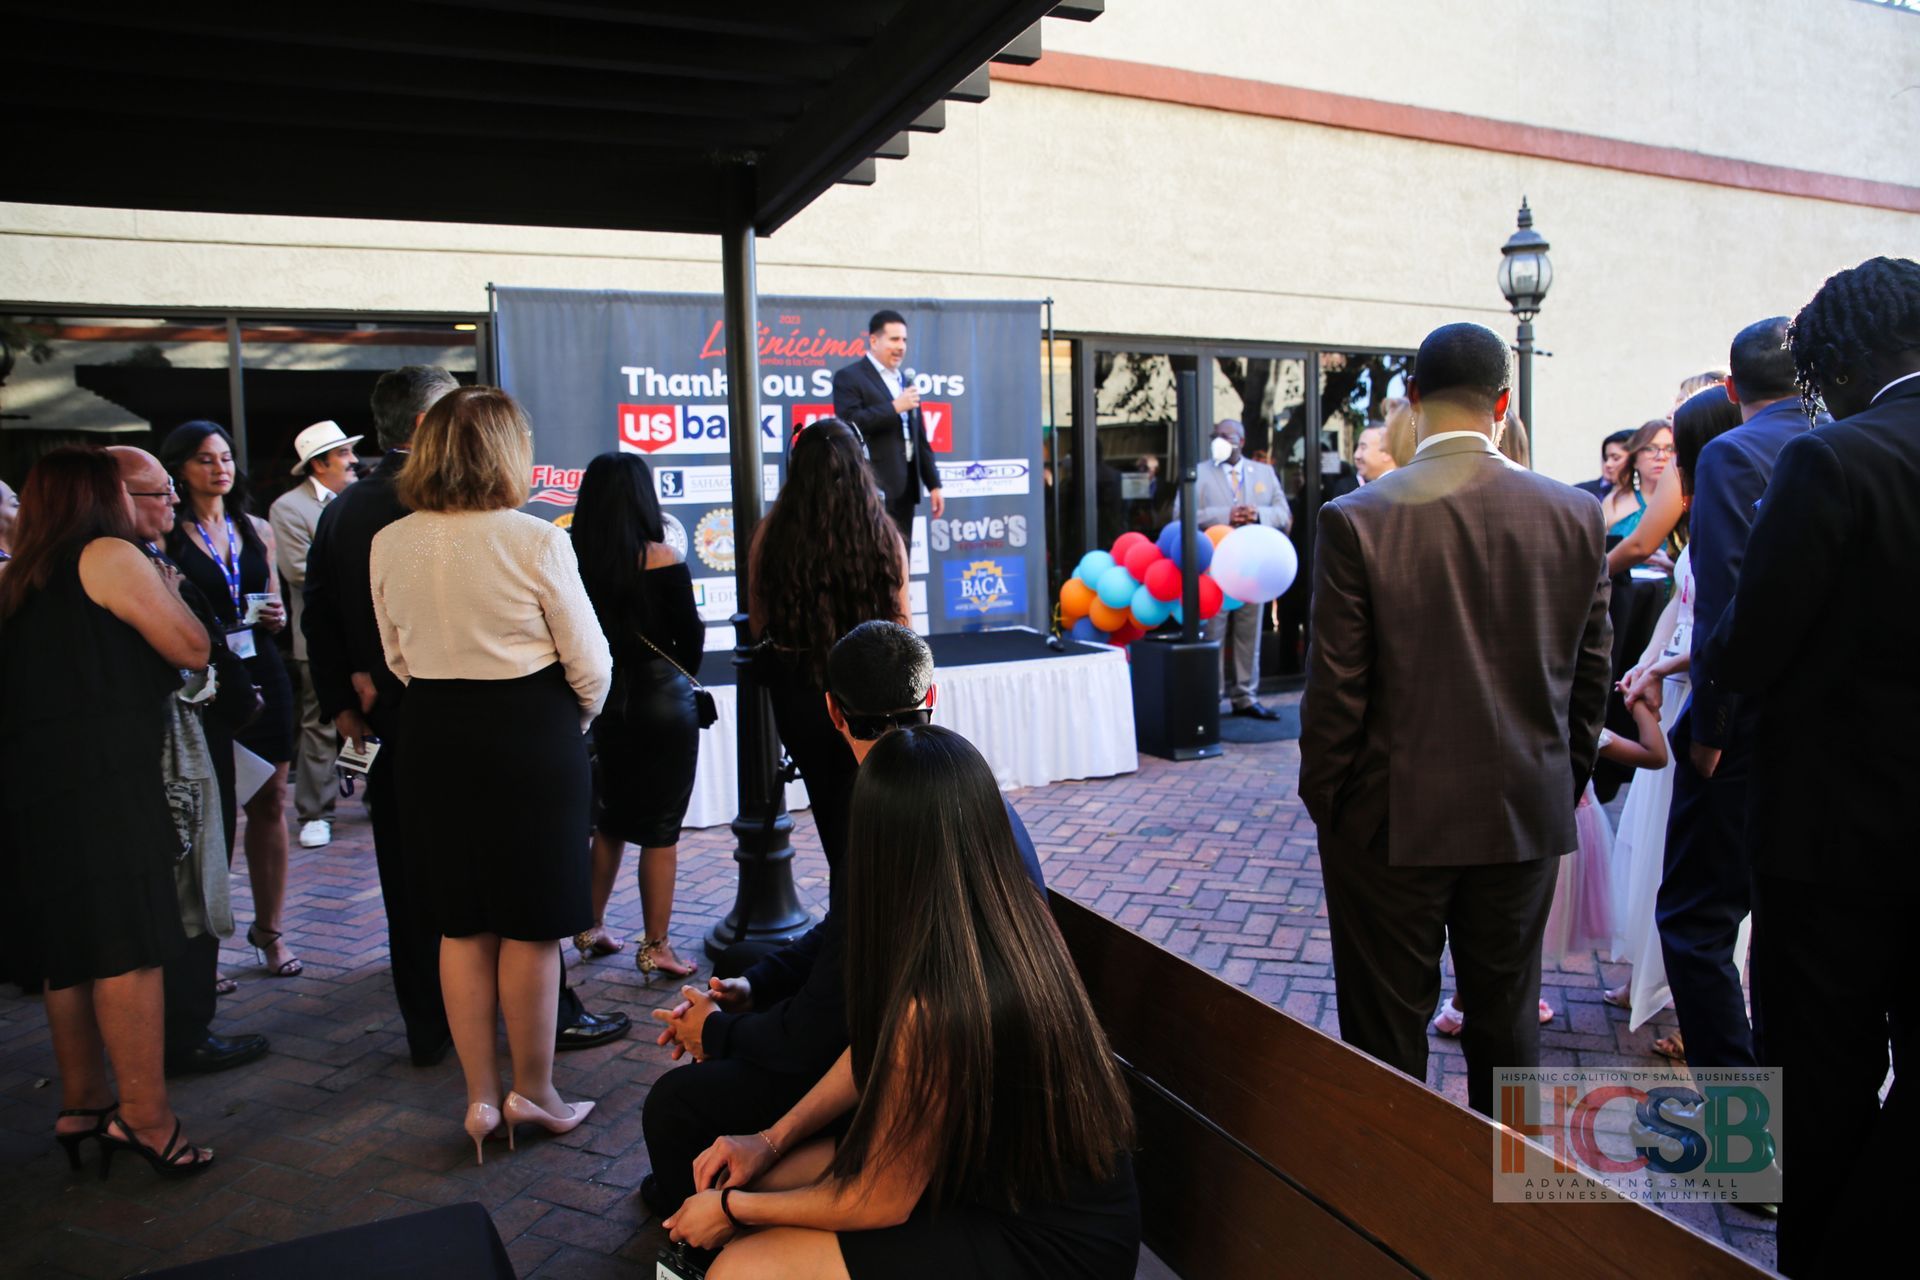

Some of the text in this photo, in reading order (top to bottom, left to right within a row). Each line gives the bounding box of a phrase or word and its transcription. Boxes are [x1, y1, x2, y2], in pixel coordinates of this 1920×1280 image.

[699, 319, 867, 360] Linícima
[762, 374, 806, 396] ou
[811, 369, 965, 397] Sors
[624, 413, 672, 441] us
[682, 405, 776, 439] bak
[962, 576, 1008, 597] BACA
